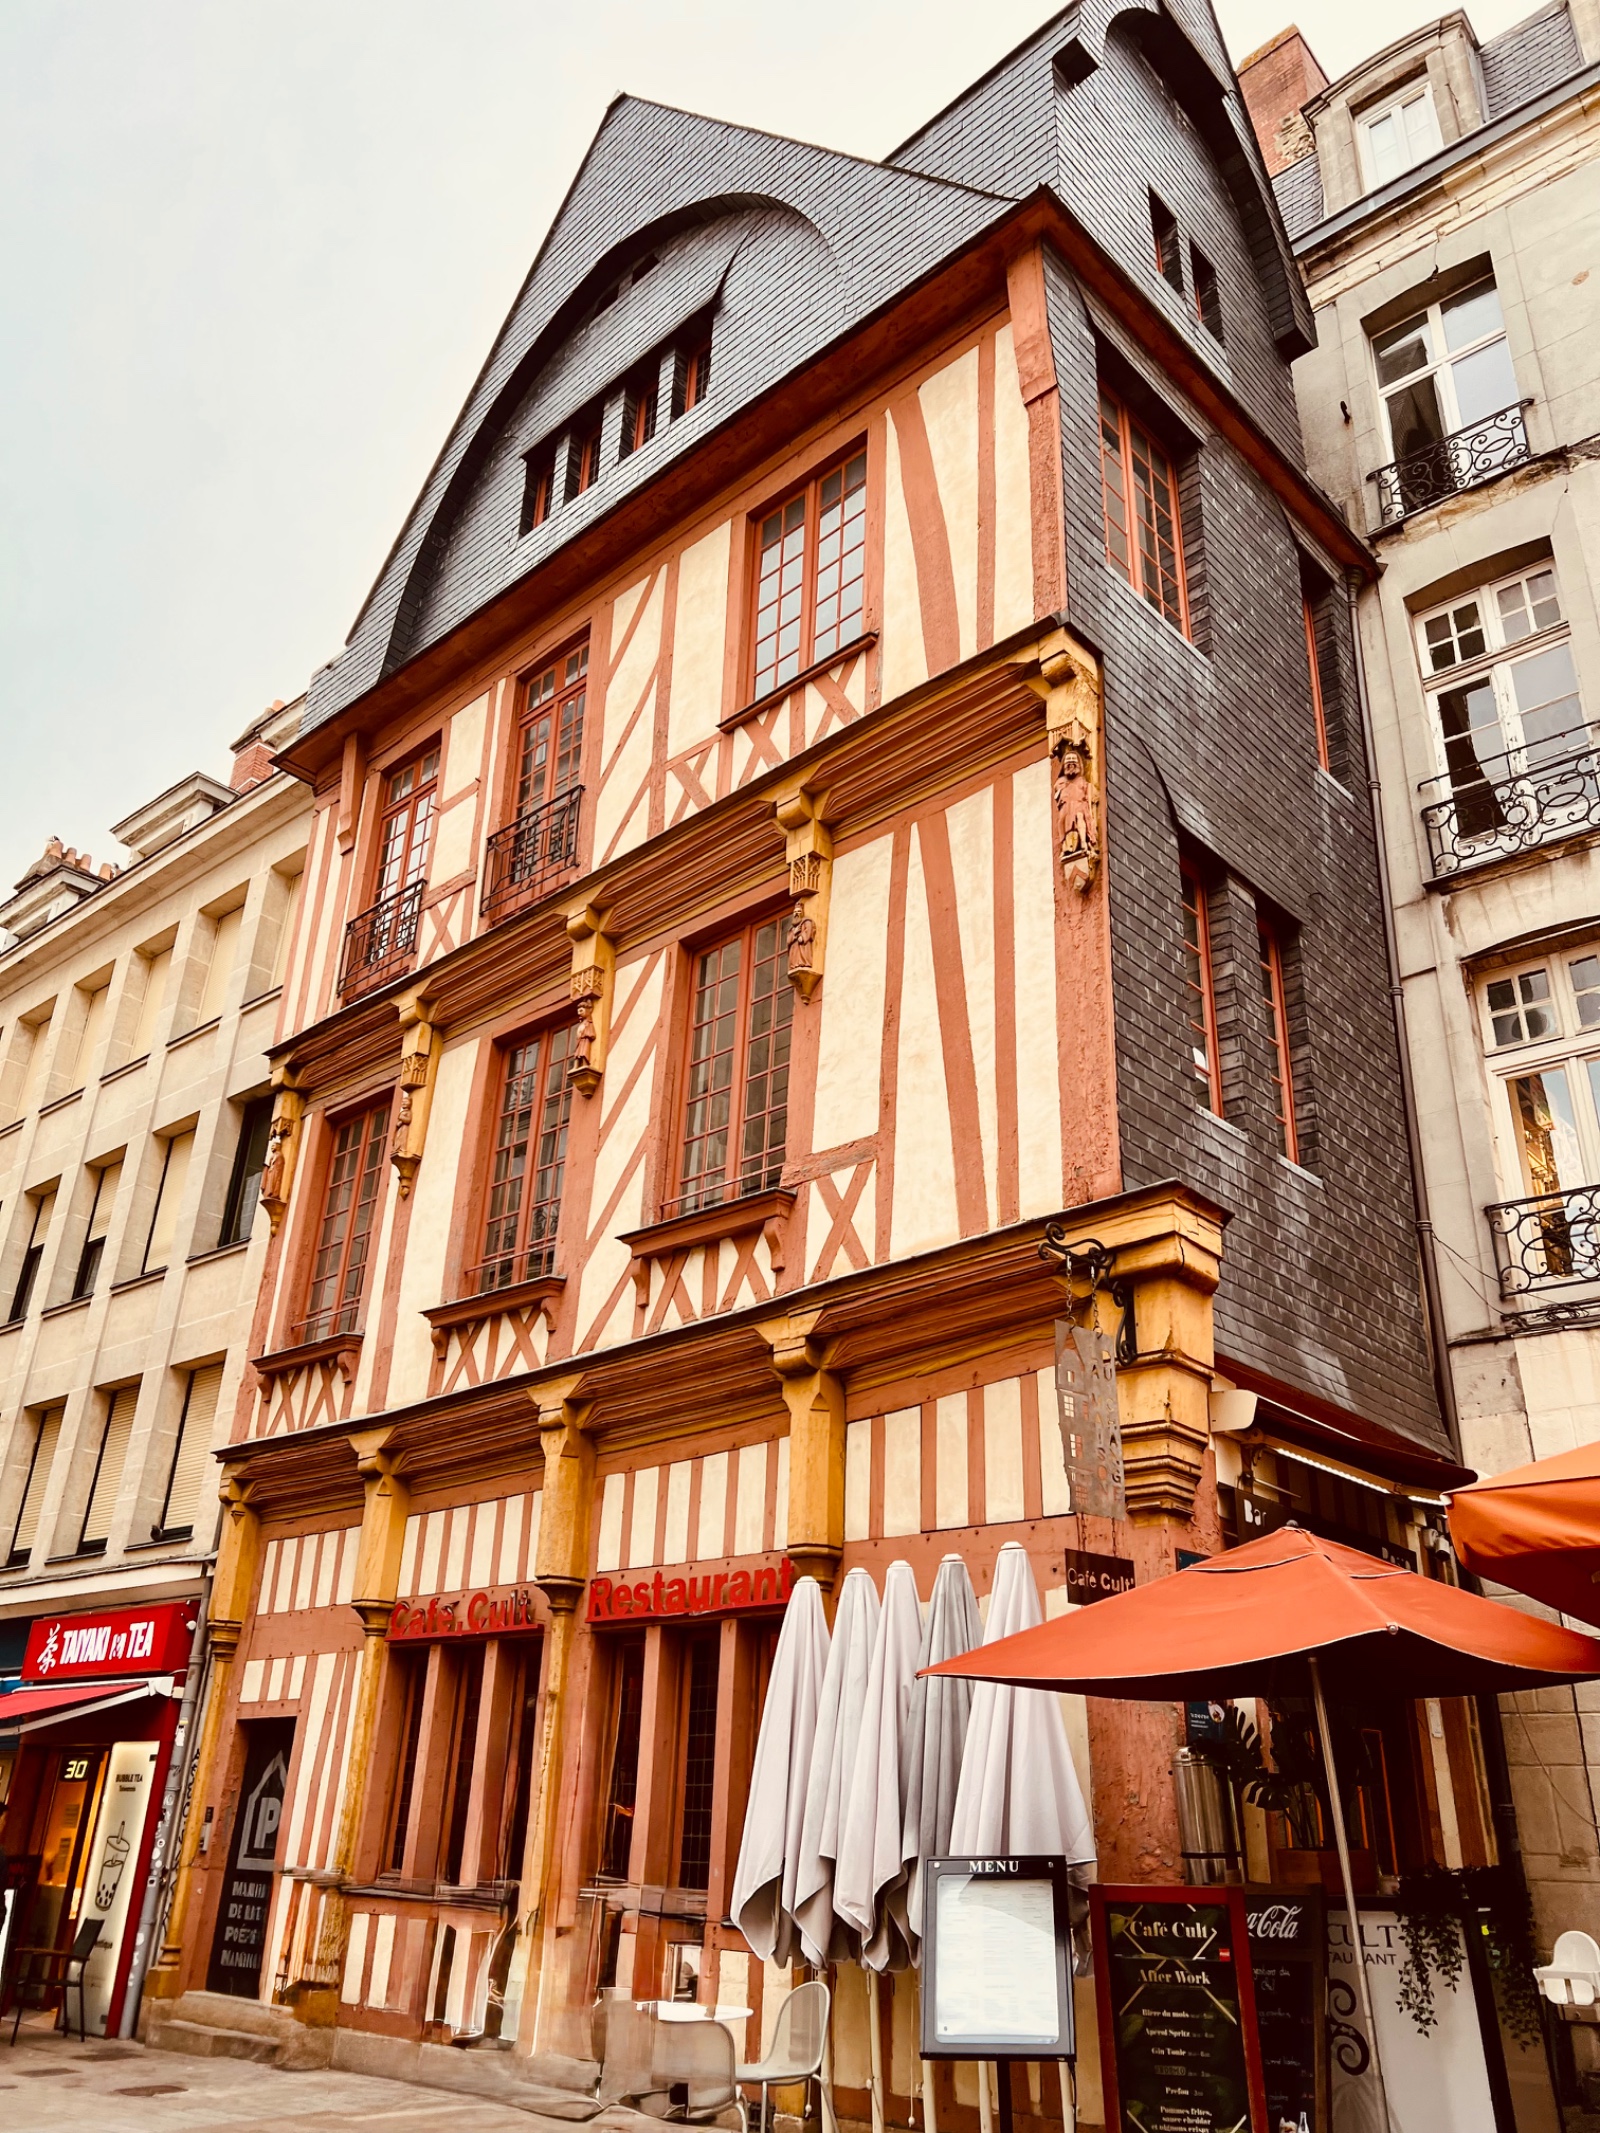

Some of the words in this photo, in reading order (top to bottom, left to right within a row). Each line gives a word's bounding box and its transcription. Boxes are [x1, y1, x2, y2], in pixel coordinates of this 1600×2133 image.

[1243, 1498, 1267, 1527] Bar
[1068, 1567, 1097, 1588] Café
[587, 1557, 795, 1620] Restaurant
[467, 1589, 532, 1630] Cult
[126, 1621, 155, 1659] TEA
[64, 1760, 88, 1779] 30
[968, 1860, 1019, 1873] MENU
[1129, 1921, 1168, 1937] Café
[1171, 1921, 1208, 1938] Cult
[1138, 1969, 1172, 1983] After
[1174, 1970, 1211, 1984] Work
[1168, 2029, 1190, 2038] Spritz
[1151, 2047, 1165, 2056] Gin
